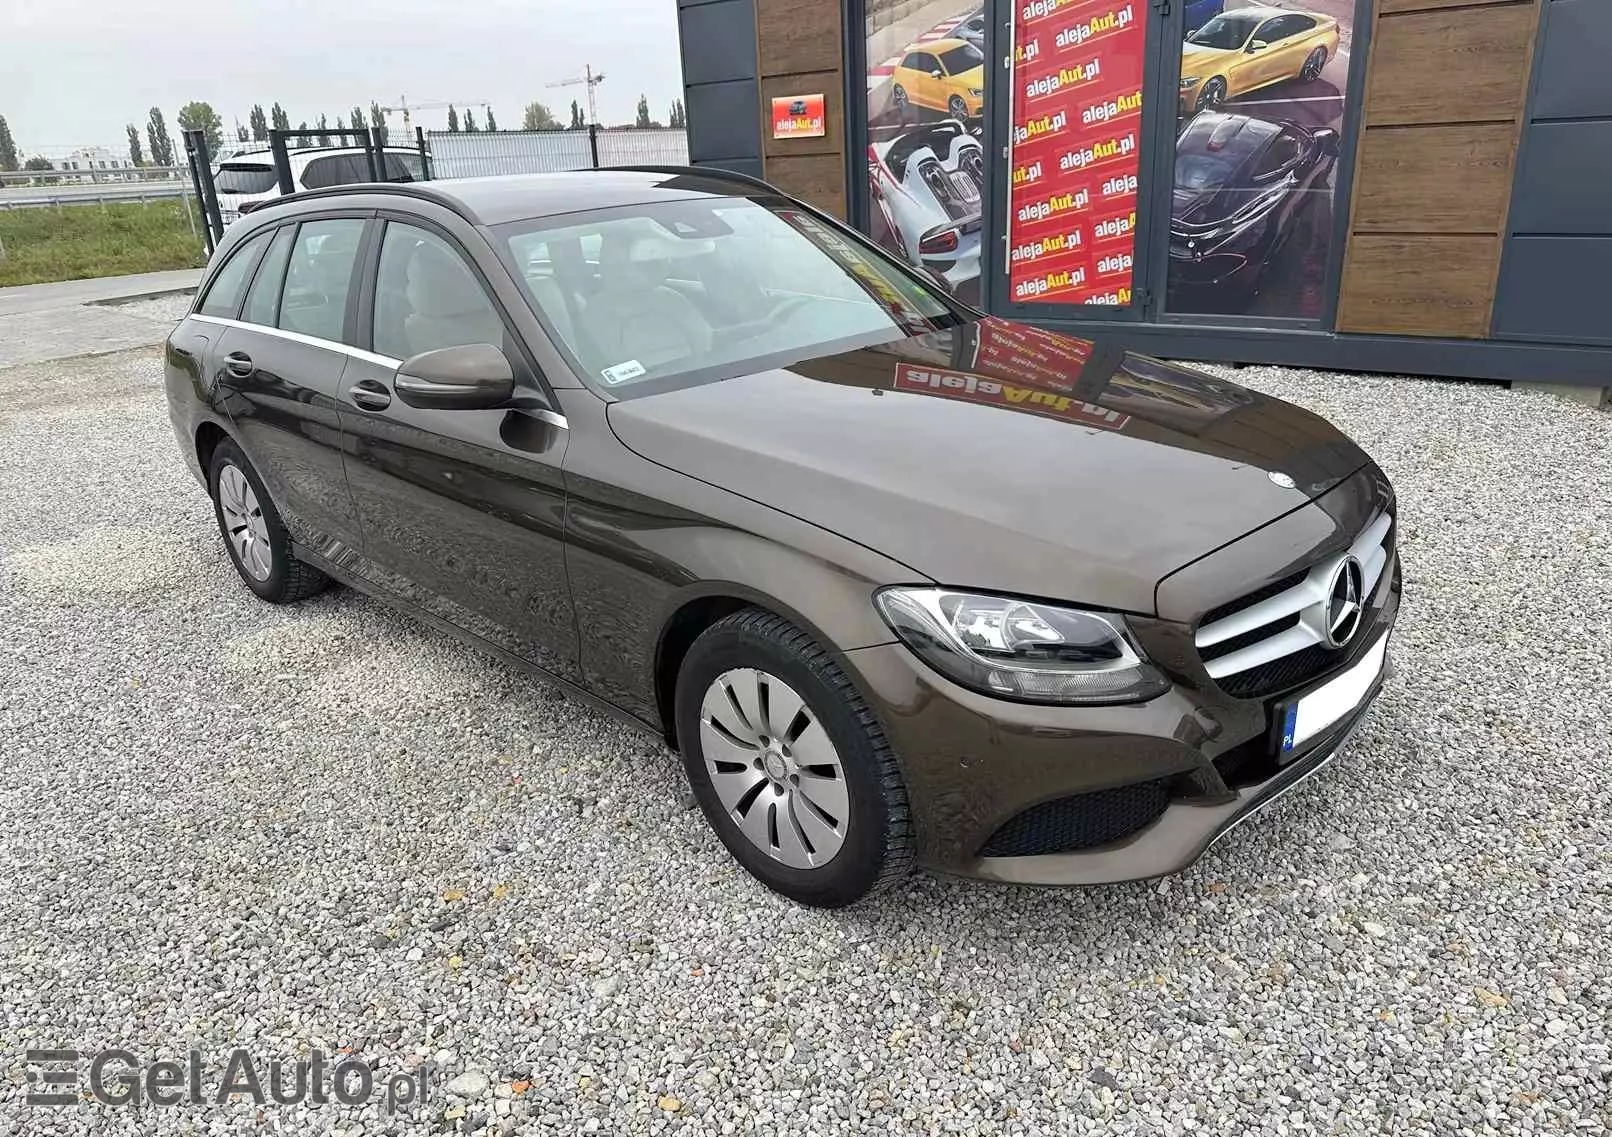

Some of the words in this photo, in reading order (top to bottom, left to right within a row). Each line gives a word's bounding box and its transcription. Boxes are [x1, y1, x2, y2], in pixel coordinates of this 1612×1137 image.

[1055, 4, 1133, 47] alejaAut.pl
[1026, 58, 1100, 97] alejaAut.pl
[1082, 90, 1142, 123] alejaAut
[776, 117, 822, 132] alejaAut.pl
[1059, 134, 1135, 170] alejaAut.pl
[1102, 174, 1138, 195] aleja
[1018, 189, 1088, 221] alejaAut.pl
[1011, 230, 1081, 261] alejaAut.pl
[1016, 267, 1085, 296] alejaAut.pl
[1283, 734, 1293, 746] PL
